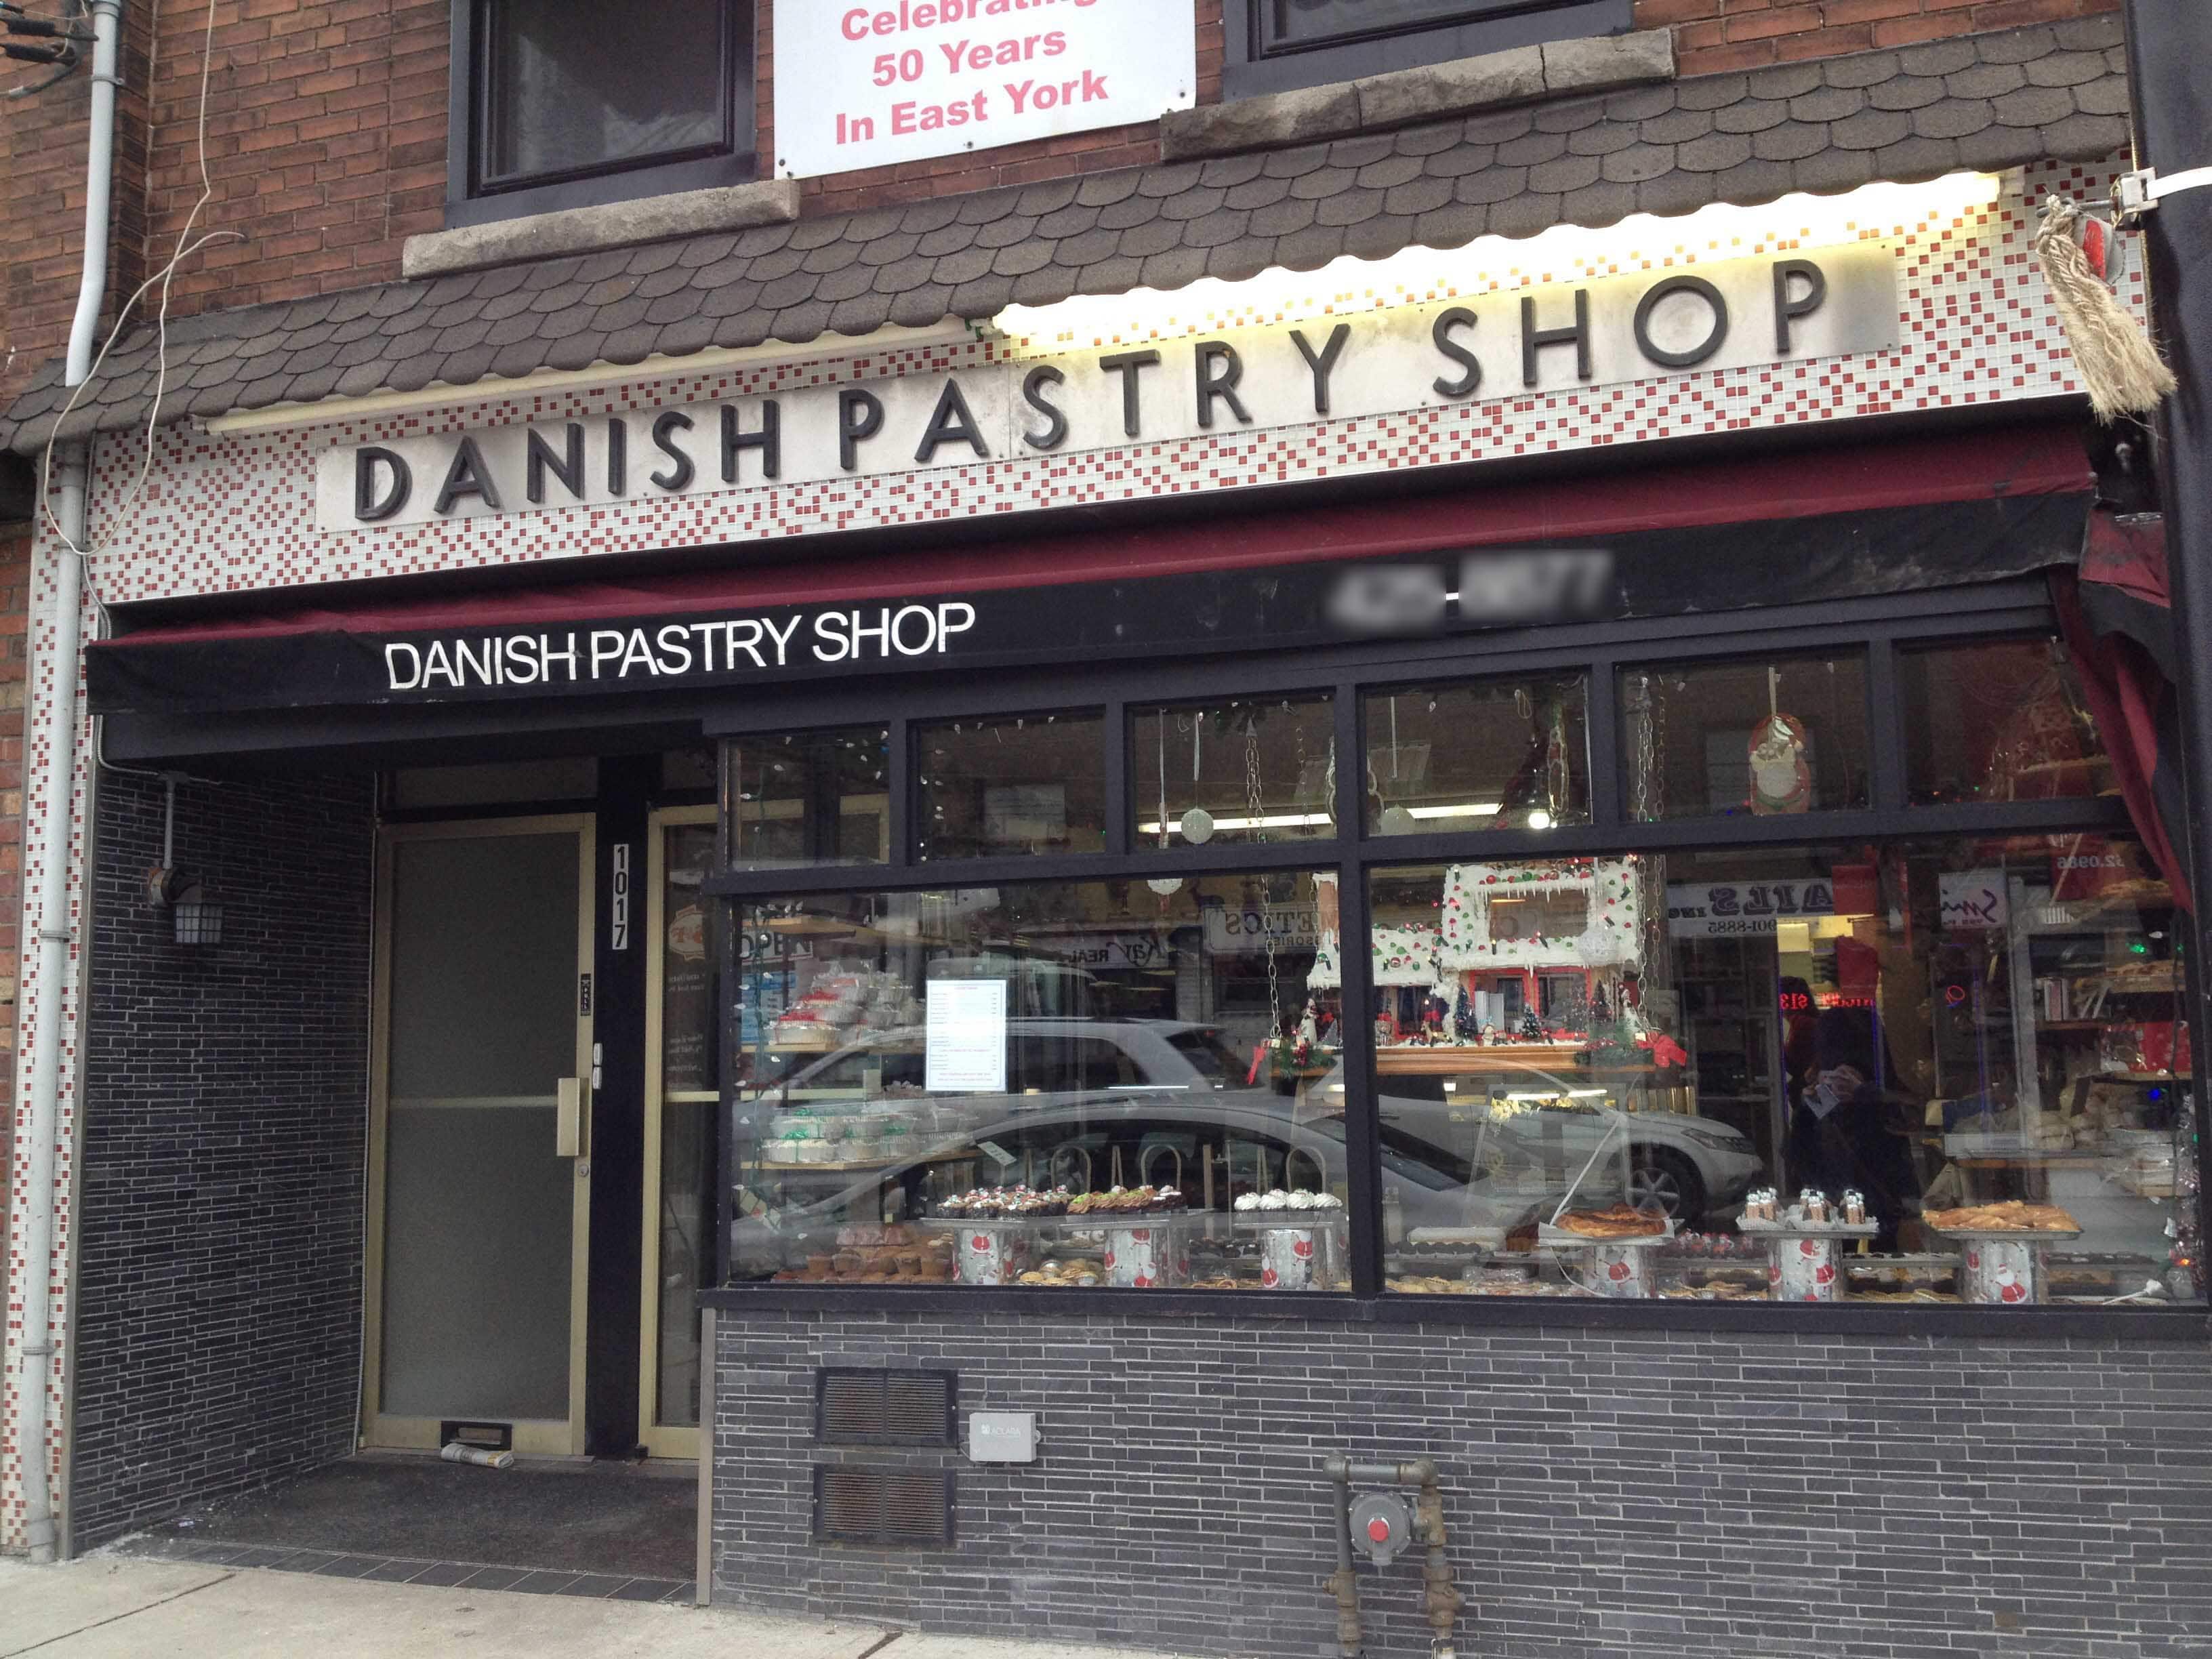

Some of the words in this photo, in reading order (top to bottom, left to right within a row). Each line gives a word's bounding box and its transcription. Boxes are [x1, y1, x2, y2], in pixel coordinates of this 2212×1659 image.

[842, 0, 1097, 41] Celebra
[874, 49, 924, 87] 50
[941, 31, 1067, 74] Years
[837, 113, 874, 144] In
[892, 91, 987, 135] East
[1004, 70, 1109, 115] York
[354, 398, 781, 522] DANISH
[838, 323, 1351, 471] PASTRY
[1433, 259, 1826, 397] SHOP
[385, 632, 577, 690] DANISH
[590, 615, 802, 679] PASTRY
[813, 602, 976, 661] SHOP
[613, 846, 628, 948] 1017
